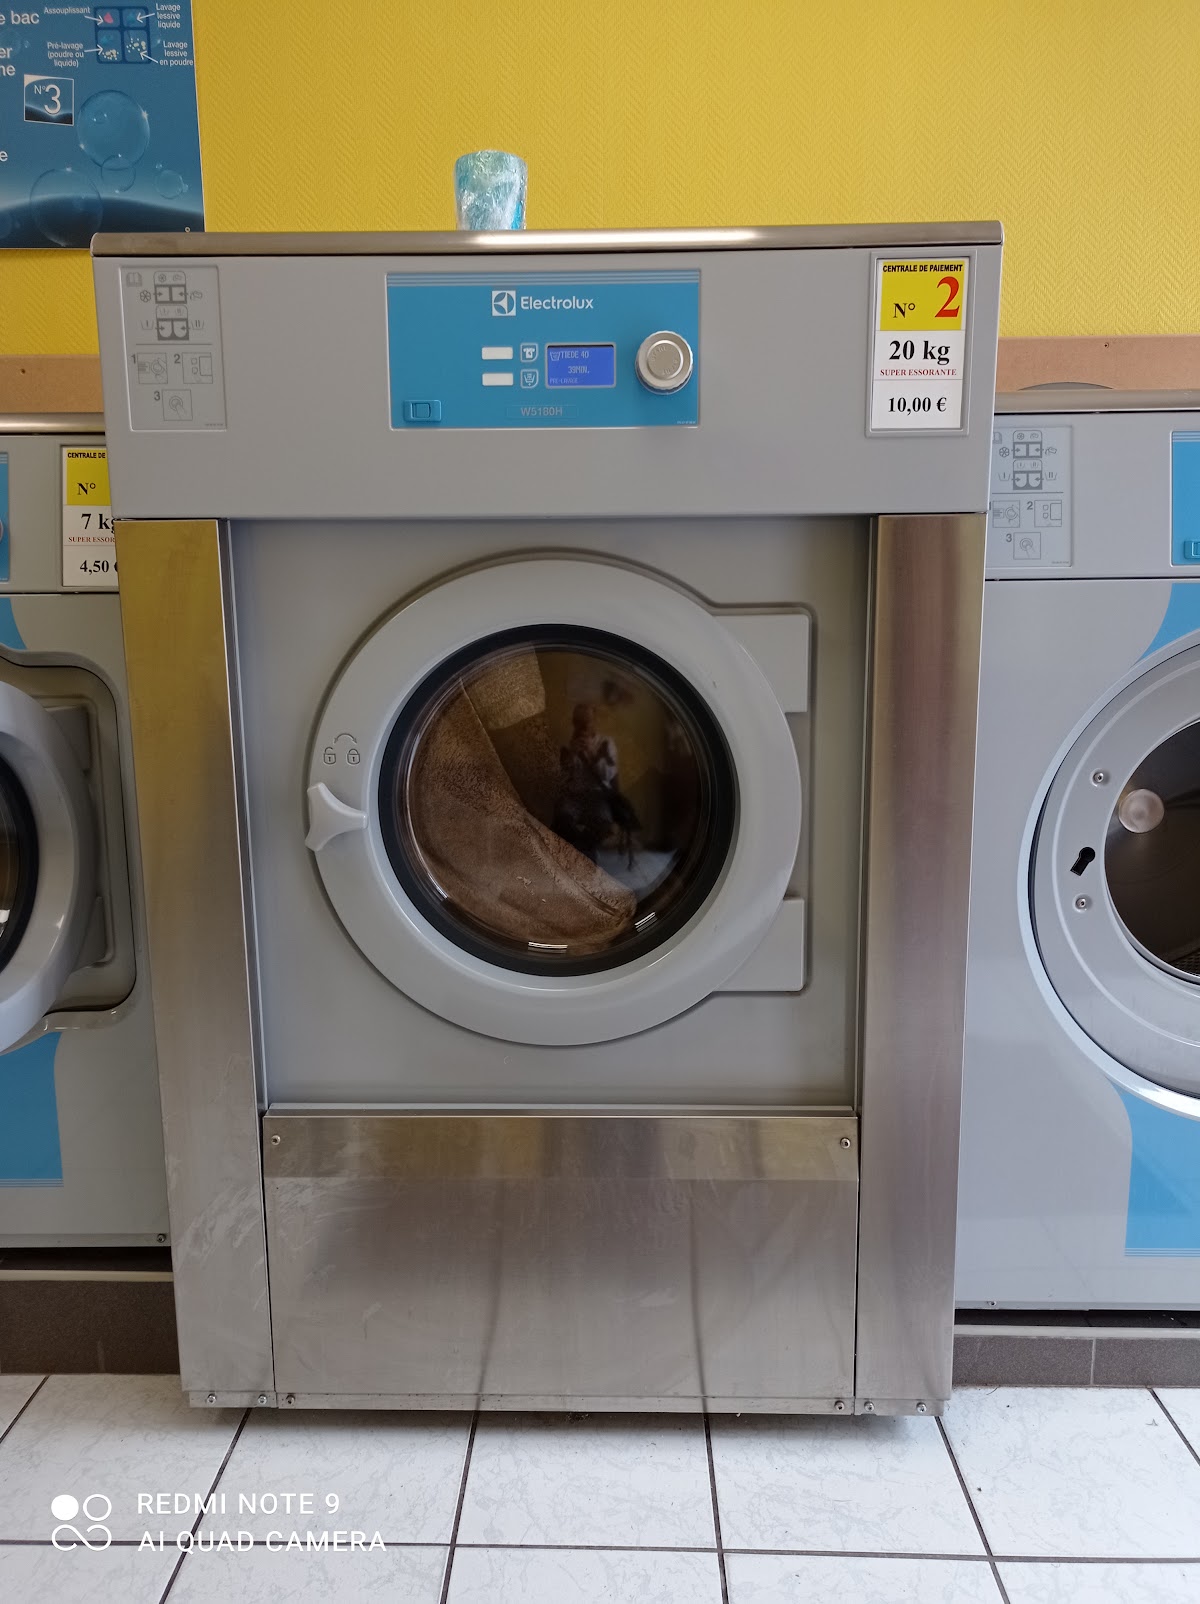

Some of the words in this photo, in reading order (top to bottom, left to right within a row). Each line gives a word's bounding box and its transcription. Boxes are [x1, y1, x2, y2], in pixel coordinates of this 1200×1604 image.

[44, 6, 90, 15] Assouplissant
[156, 3, 181, 12] Lavage
[11, 10, 40, 25] bac
[157, 12, 181, 20] lessive
[158, 21, 181, 29] liquide
[47, 41, 84, 51] Pré-lavage
[163, 40, 188, 49] Lavage
[48, 51, 74, 60] (poudre
[164, 49, 188, 57] lessive
[54, 59, 79, 68] liquide)
[170, 58, 194, 67] poudre
[929, 264, 963, 272] PAIEMENT
[893, 303, 916, 318] N°
[935, 276, 960, 317] 2
[520, 296, 594, 310] Electrolux
[580, 350, 590, 359] 40
[889, 340, 915, 360] 20
[922, 340, 951, 365] kg
[173, 354, 181, 364] 2
[154, 390, 160, 401] 3
[888, 397, 932, 416] 10,00
[936, 397, 947, 412] €
[520, 407, 563, 416] W5180H
[77, 482, 97, 495] N°
[1027, 501, 1033, 510] 2
[81, 513, 92, 530] 7
[1006, 534, 1012, 543] 3
[80, 560, 110, 576] 4,50
